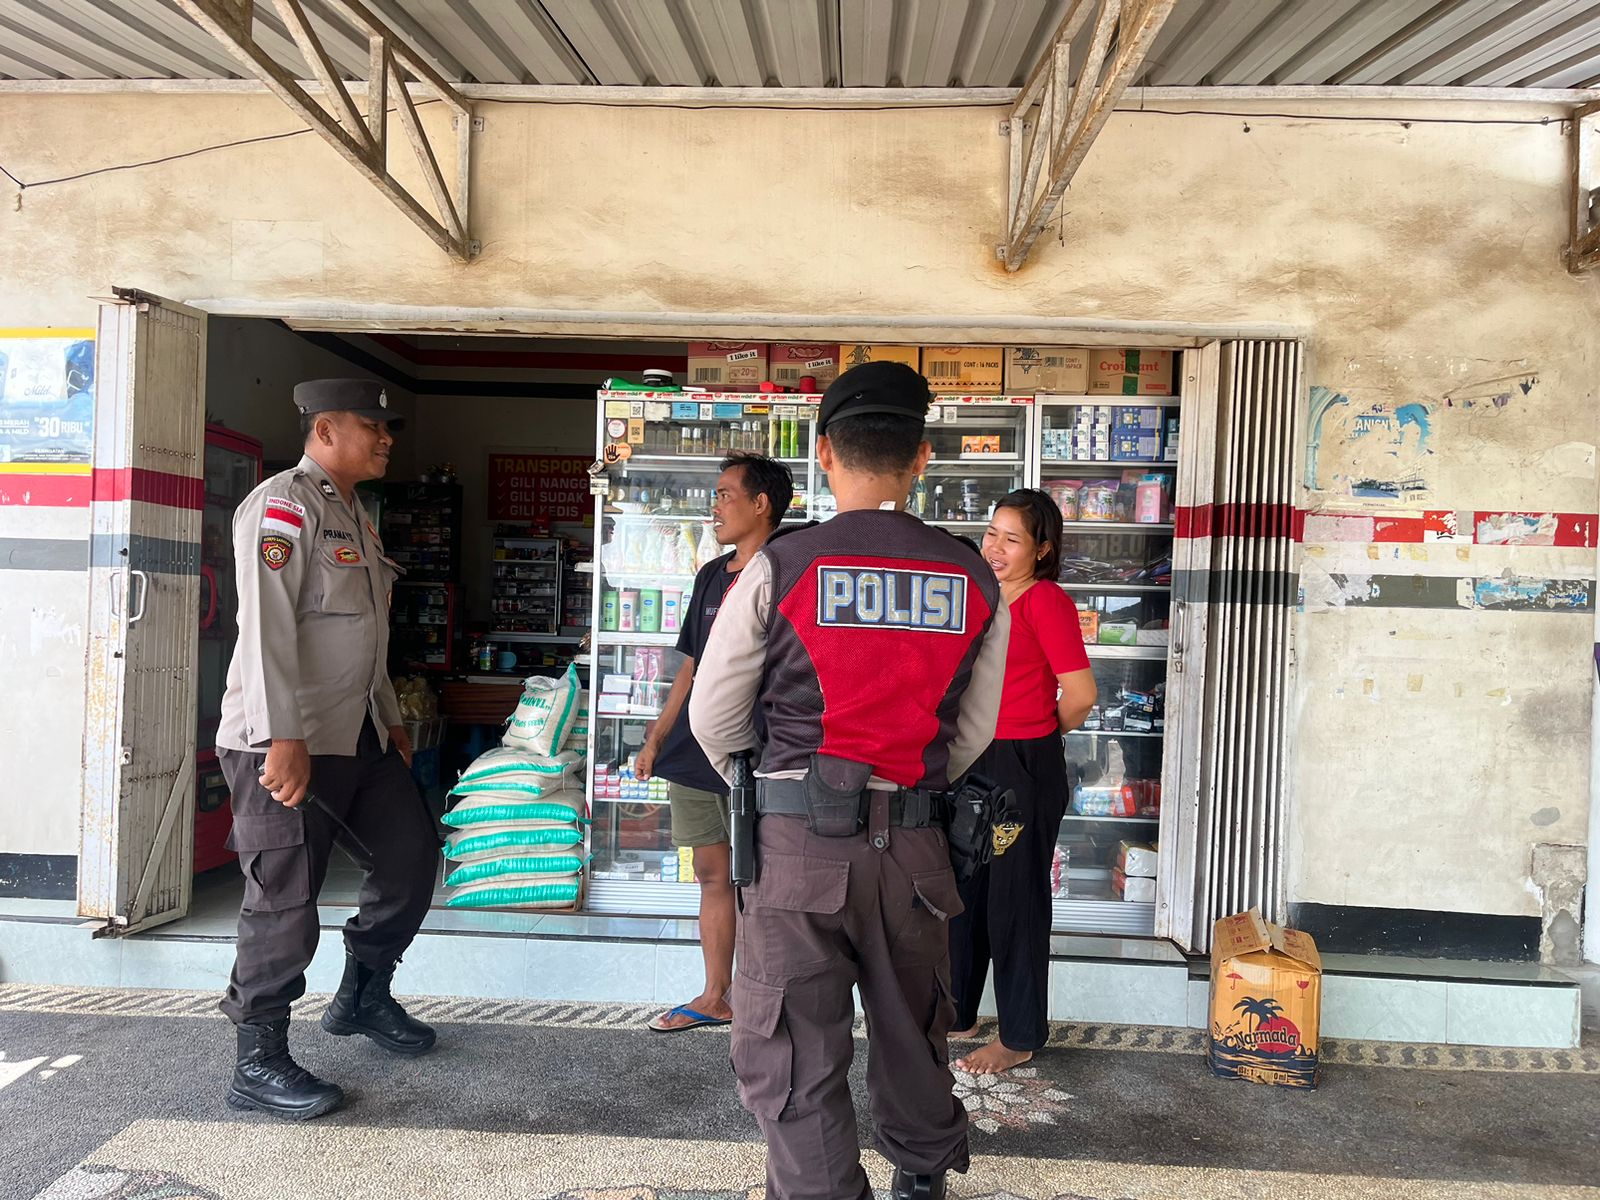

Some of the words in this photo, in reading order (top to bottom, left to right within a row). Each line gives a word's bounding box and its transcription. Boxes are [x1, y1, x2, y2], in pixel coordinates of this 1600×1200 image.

[741, 368, 749, 376] 20
[510, 477, 535, 488] GILI
[540, 478, 590, 489] NANGG
[510, 491, 535, 502] GILI
[540, 492, 584, 503] SUDAK
[268, 498, 302, 514] INDONESIA
[510, 505, 534, 516] GILI
[539, 506, 578, 517] KEDIS
[823, 571, 962, 628] POLISI
[1236, 1028, 1296, 1049] Narmada
